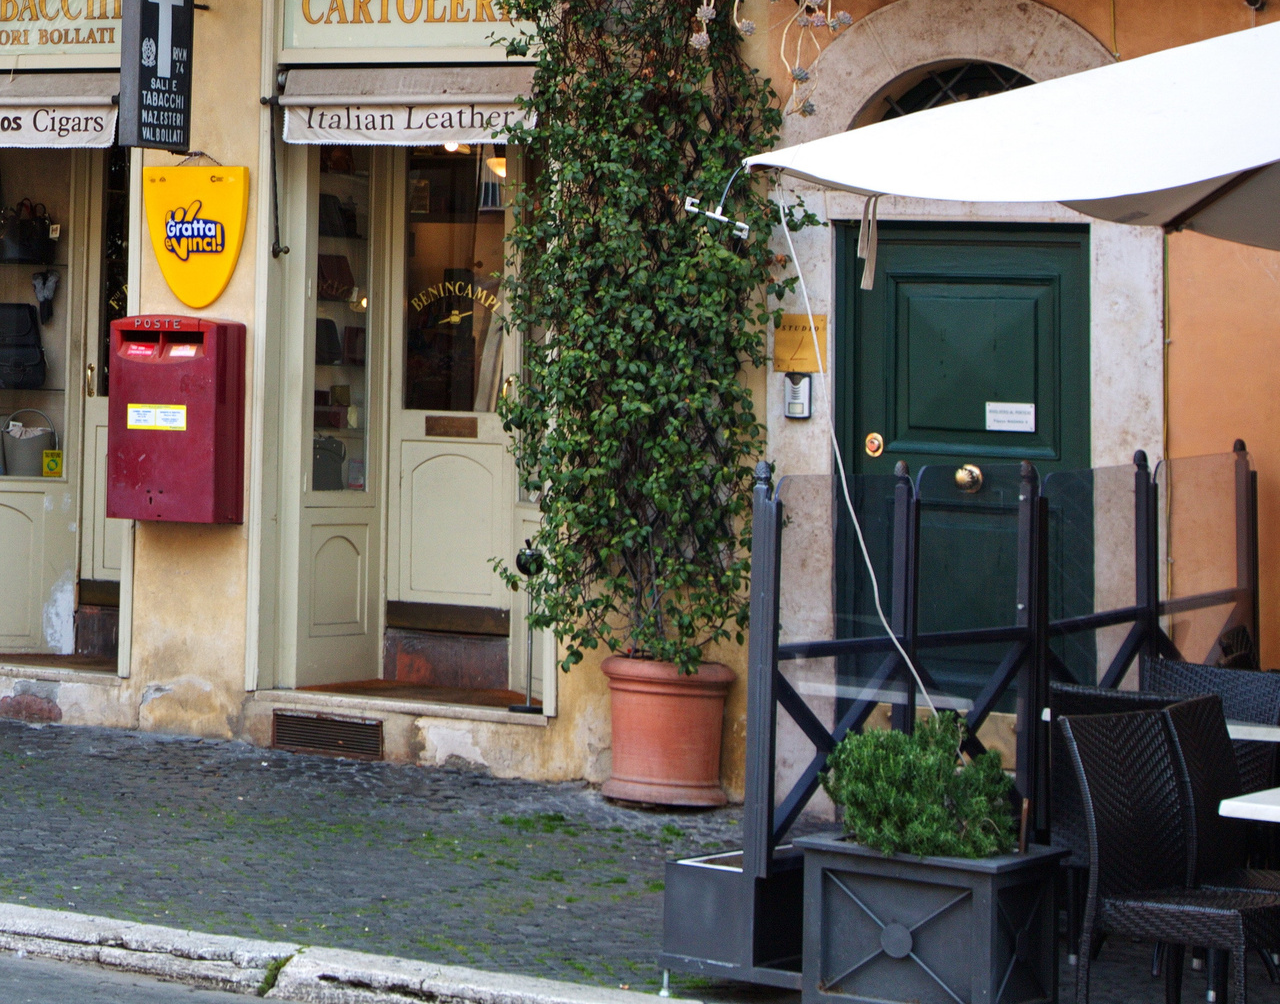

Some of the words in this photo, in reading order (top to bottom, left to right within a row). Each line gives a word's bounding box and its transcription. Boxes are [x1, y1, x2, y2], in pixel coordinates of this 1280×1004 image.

[38, 27, 116, 45] BOLLATI
[176, 63, 184, 74] 74
[150, 77, 169, 91] SALI
[172, 80, 177, 91] E
[142, 90, 184, 109] TABACCHI
[32, 108, 105, 137] Cigars
[306, 106, 394, 131] Italian
[404, 104, 515, 131] Leather
[166, 220, 216, 237] Gratta
[410, 281, 502, 313] BENINCAMPI
[134, 318, 182, 329] POSTE
[781, 324, 820, 332] STUDIO
